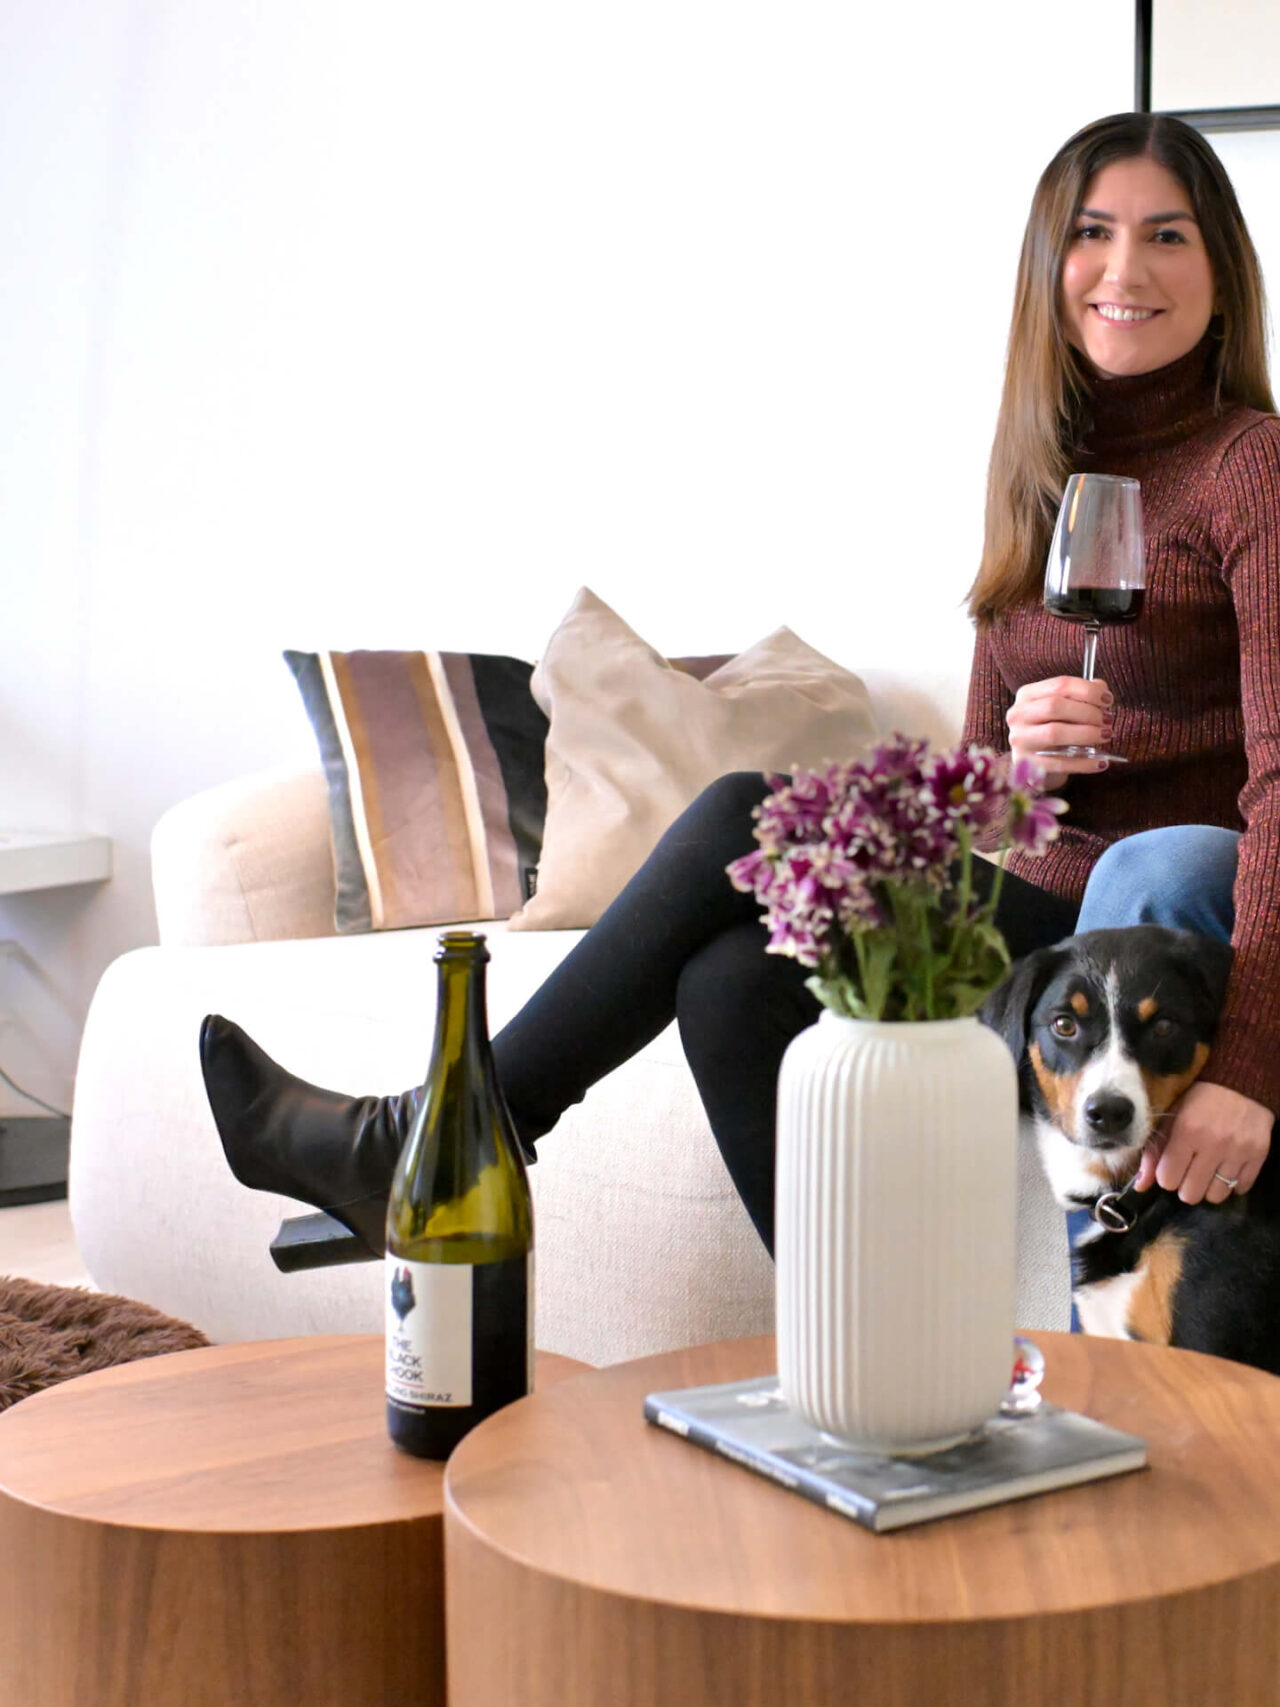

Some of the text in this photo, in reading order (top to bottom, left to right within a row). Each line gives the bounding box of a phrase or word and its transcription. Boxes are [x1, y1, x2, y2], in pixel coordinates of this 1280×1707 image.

[392, 1335, 413, 1353] THE
[388, 1349, 422, 1369] LACK
[409, 1390, 452, 1402] SHIRAZ
